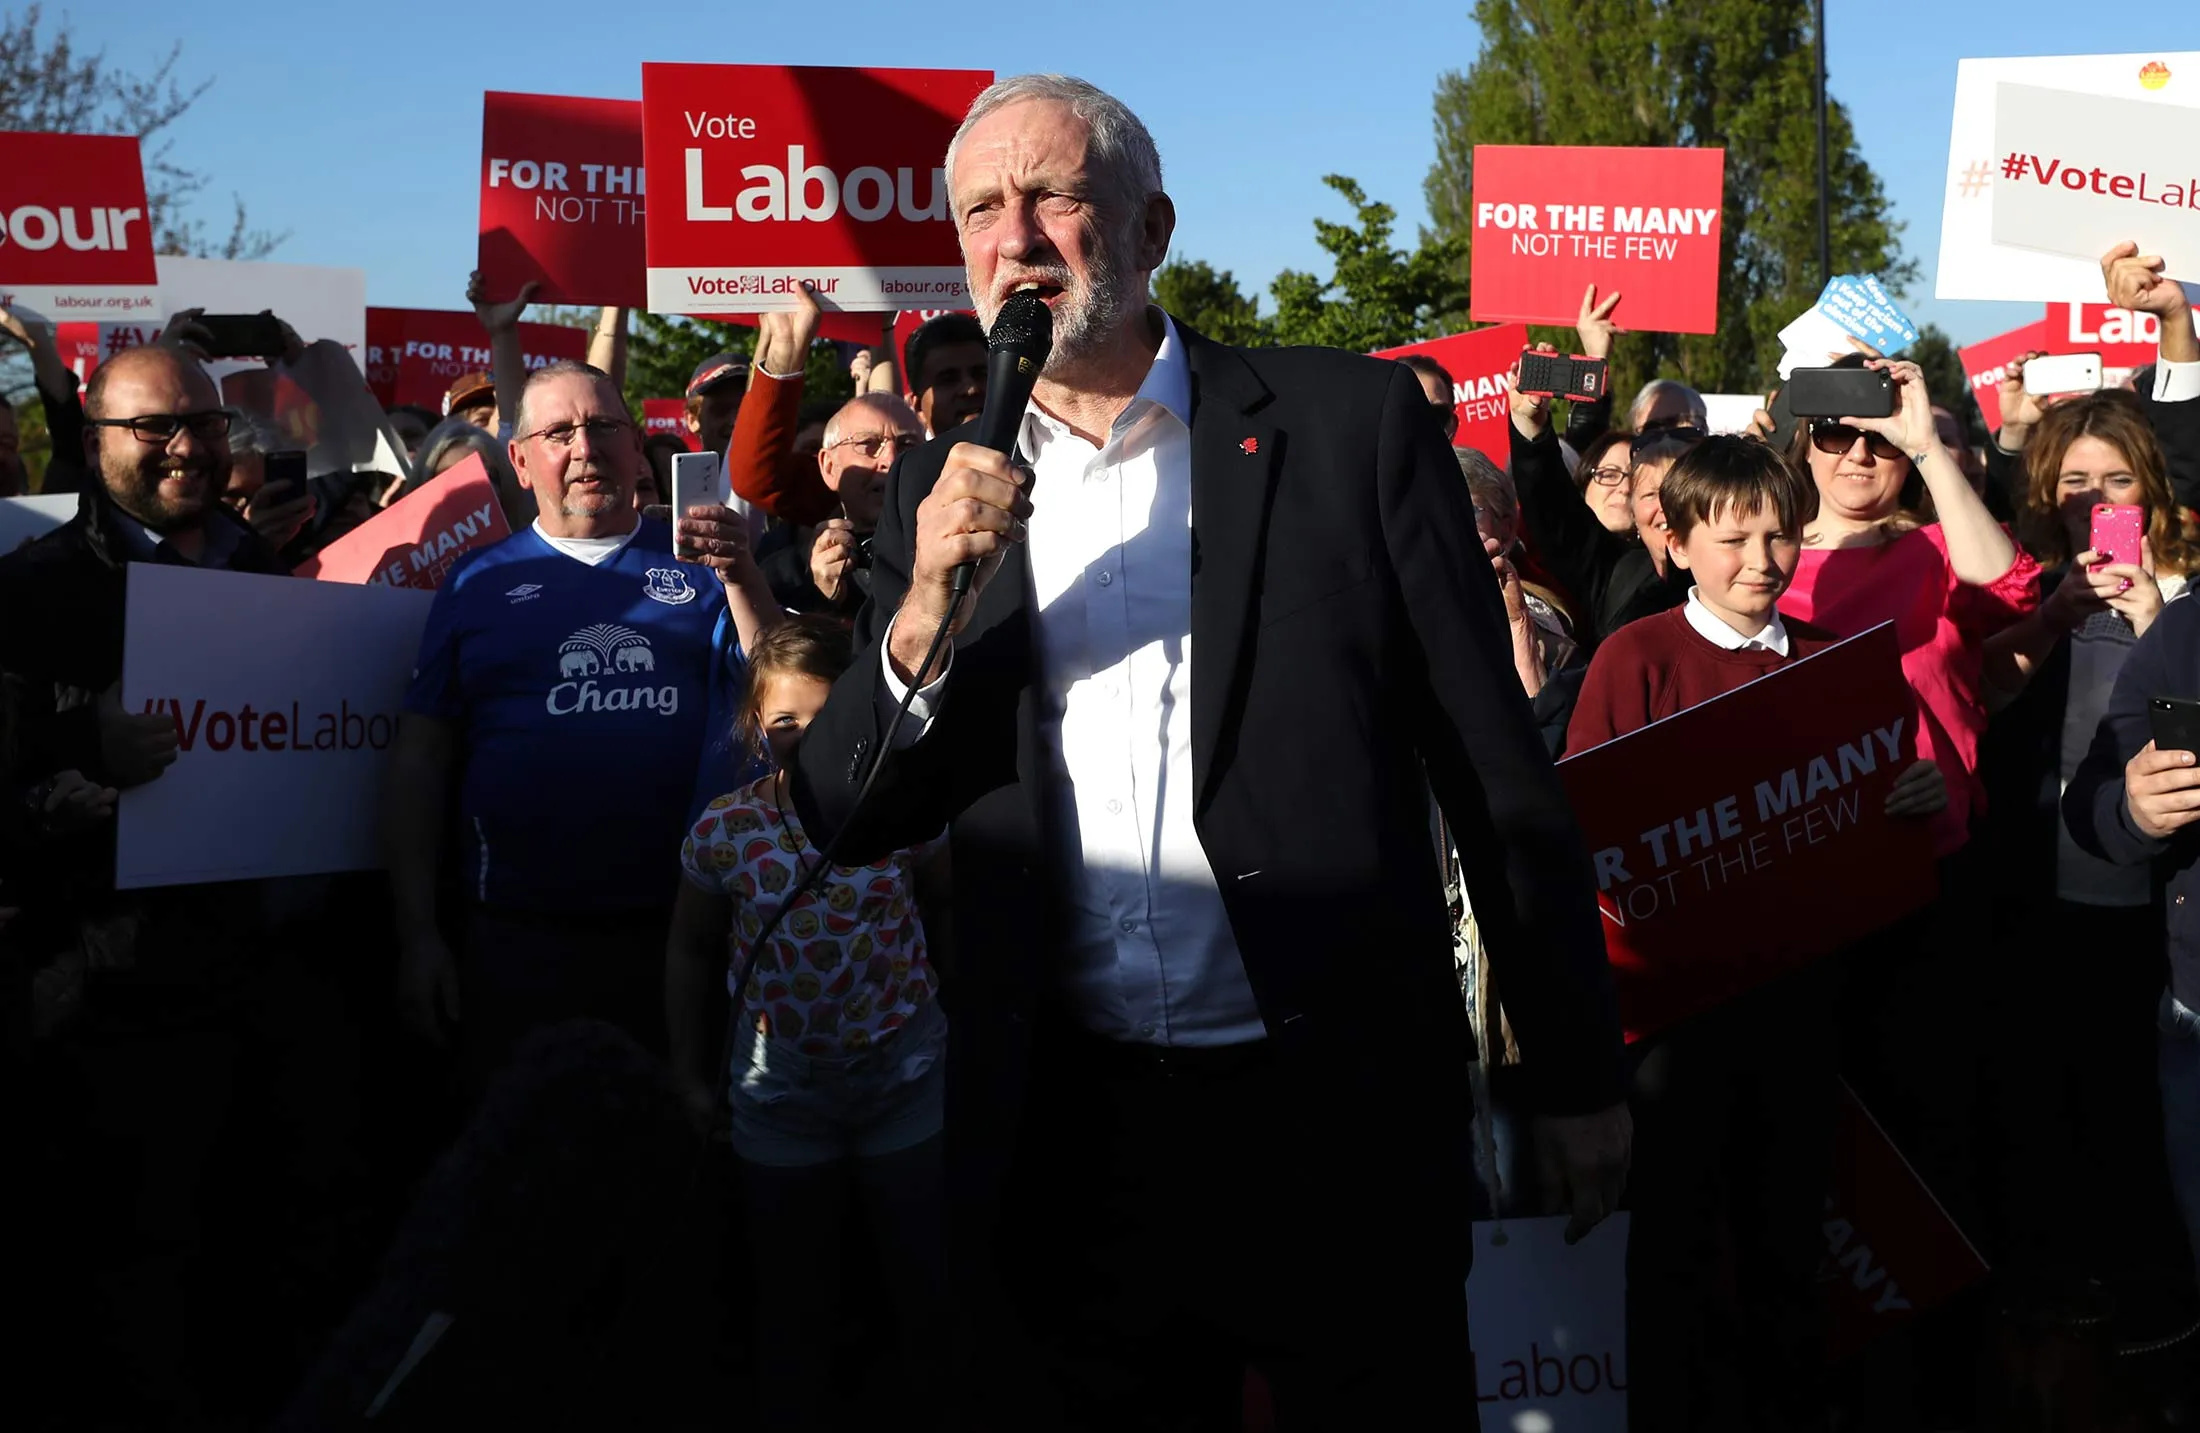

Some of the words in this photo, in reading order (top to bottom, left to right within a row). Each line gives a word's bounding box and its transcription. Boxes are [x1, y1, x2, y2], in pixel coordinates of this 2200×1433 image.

[684, 111, 756, 139] Vote
[489, 158, 569, 191] FOR
[685, 145, 956, 222] Labou
[535, 195, 603, 224] NOT
[611, 200, 646, 225] TH
[1478, 203, 1538, 229] FOR
[1546, 205, 1605, 231] THE
[1613, 207, 1717, 235] MANY
[0, 205, 142, 251] our
[1512, 233, 1564, 256] NOT
[1569, 235, 1617, 258] THE
[1625, 237, 1678, 260] FEW
[55, 296, 153, 310] labour.org.uk
[688, 276, 738, 295] Vote
[2069, 302, 2162, 344] Lab
[405, 340, 452, 361] FOR
[459, 346, 492, 365] TH
[1453, 371, 1515, 405] MAN
[1465, 397, 1506, 423] FEW
[370, 561, 407, 587] HE
[410, 503, 493, 572] MANY
[546, 680, 679, 716] Chang
[144, 698, 400, 751] VoteLabo
[1640, 795, 1742, 868] THE
[1754, 717, 1905, 823] MANY
[1600, 870, 1681, 927] NOT
[1691, 832, 1773, 892] THE
[1783, 789, 1859, 855] FEW
[1822, 1195, 1912, 1314] ANY
[1470, 1343, 1628, 1401] Labou
